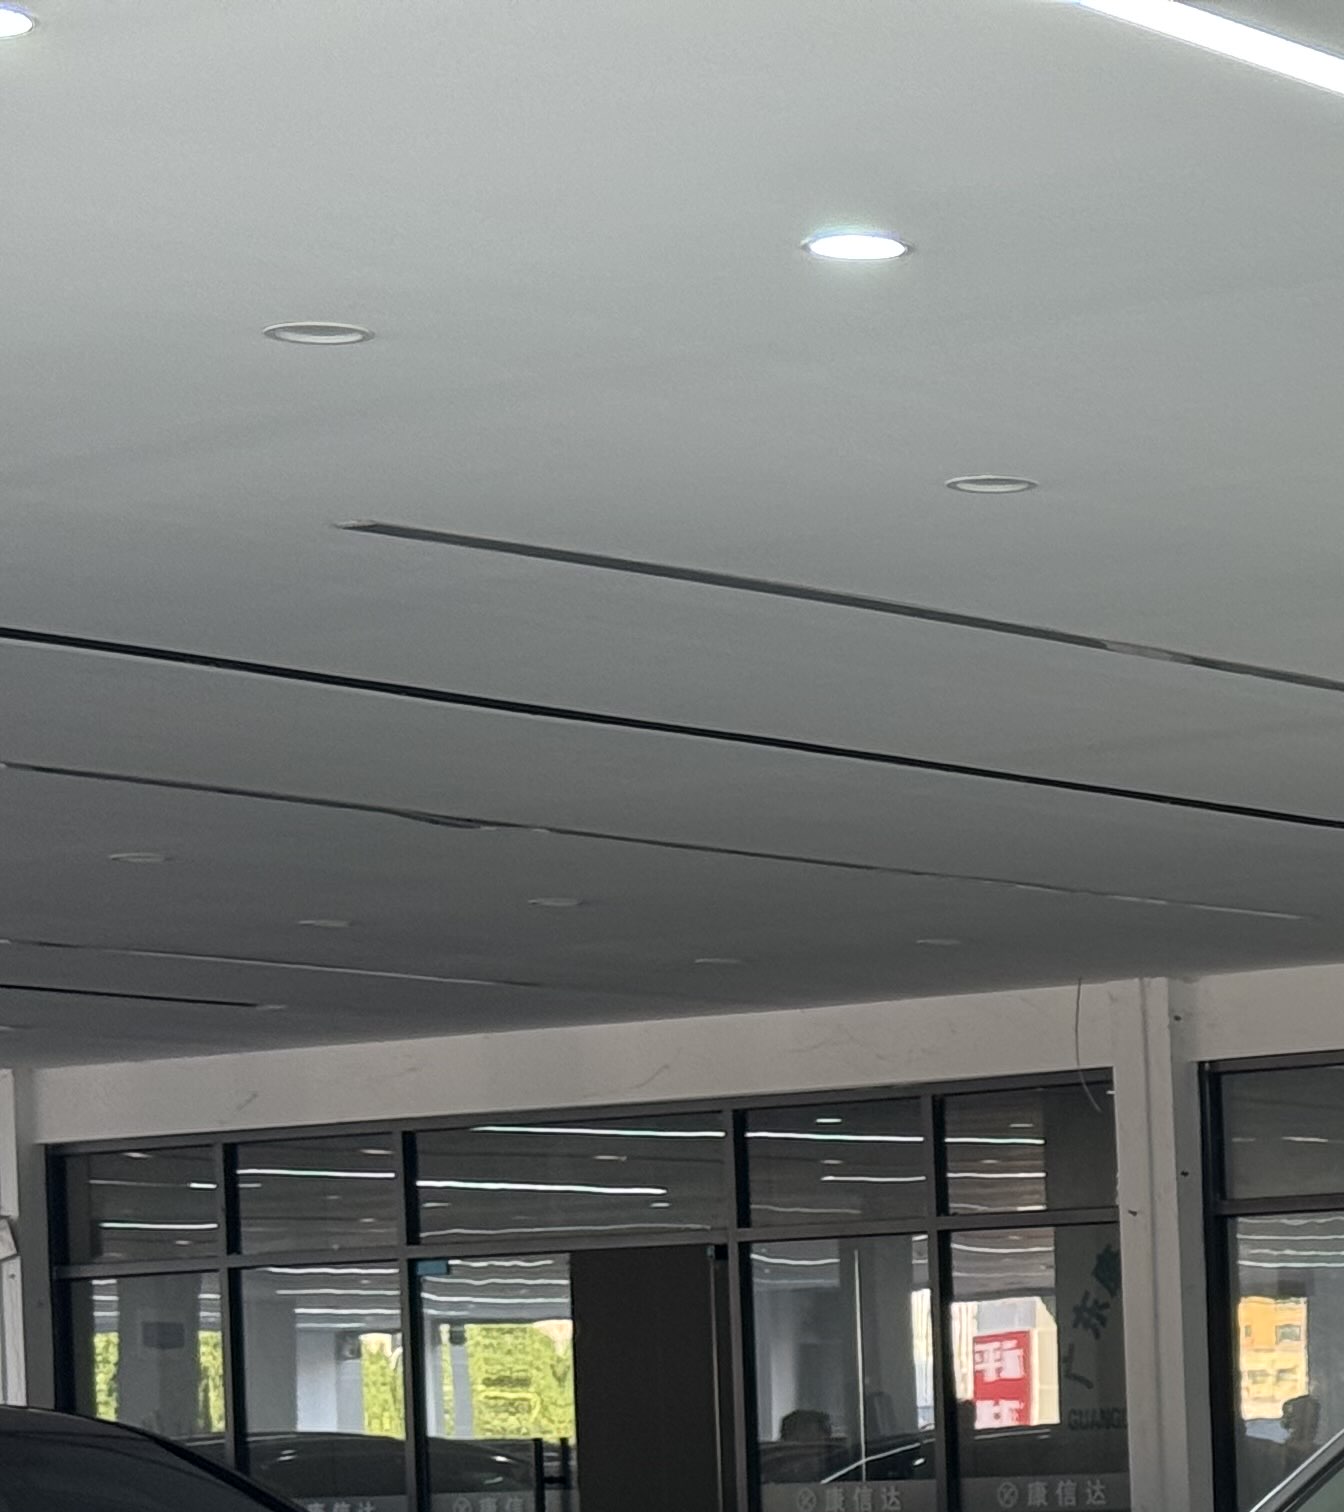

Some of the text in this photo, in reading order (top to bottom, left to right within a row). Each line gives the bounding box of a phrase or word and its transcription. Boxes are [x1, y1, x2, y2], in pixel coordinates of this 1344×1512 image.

[824, 1485, 903, 1512] 康信达
[1026, 1479, 1108, 1507] 康信达
